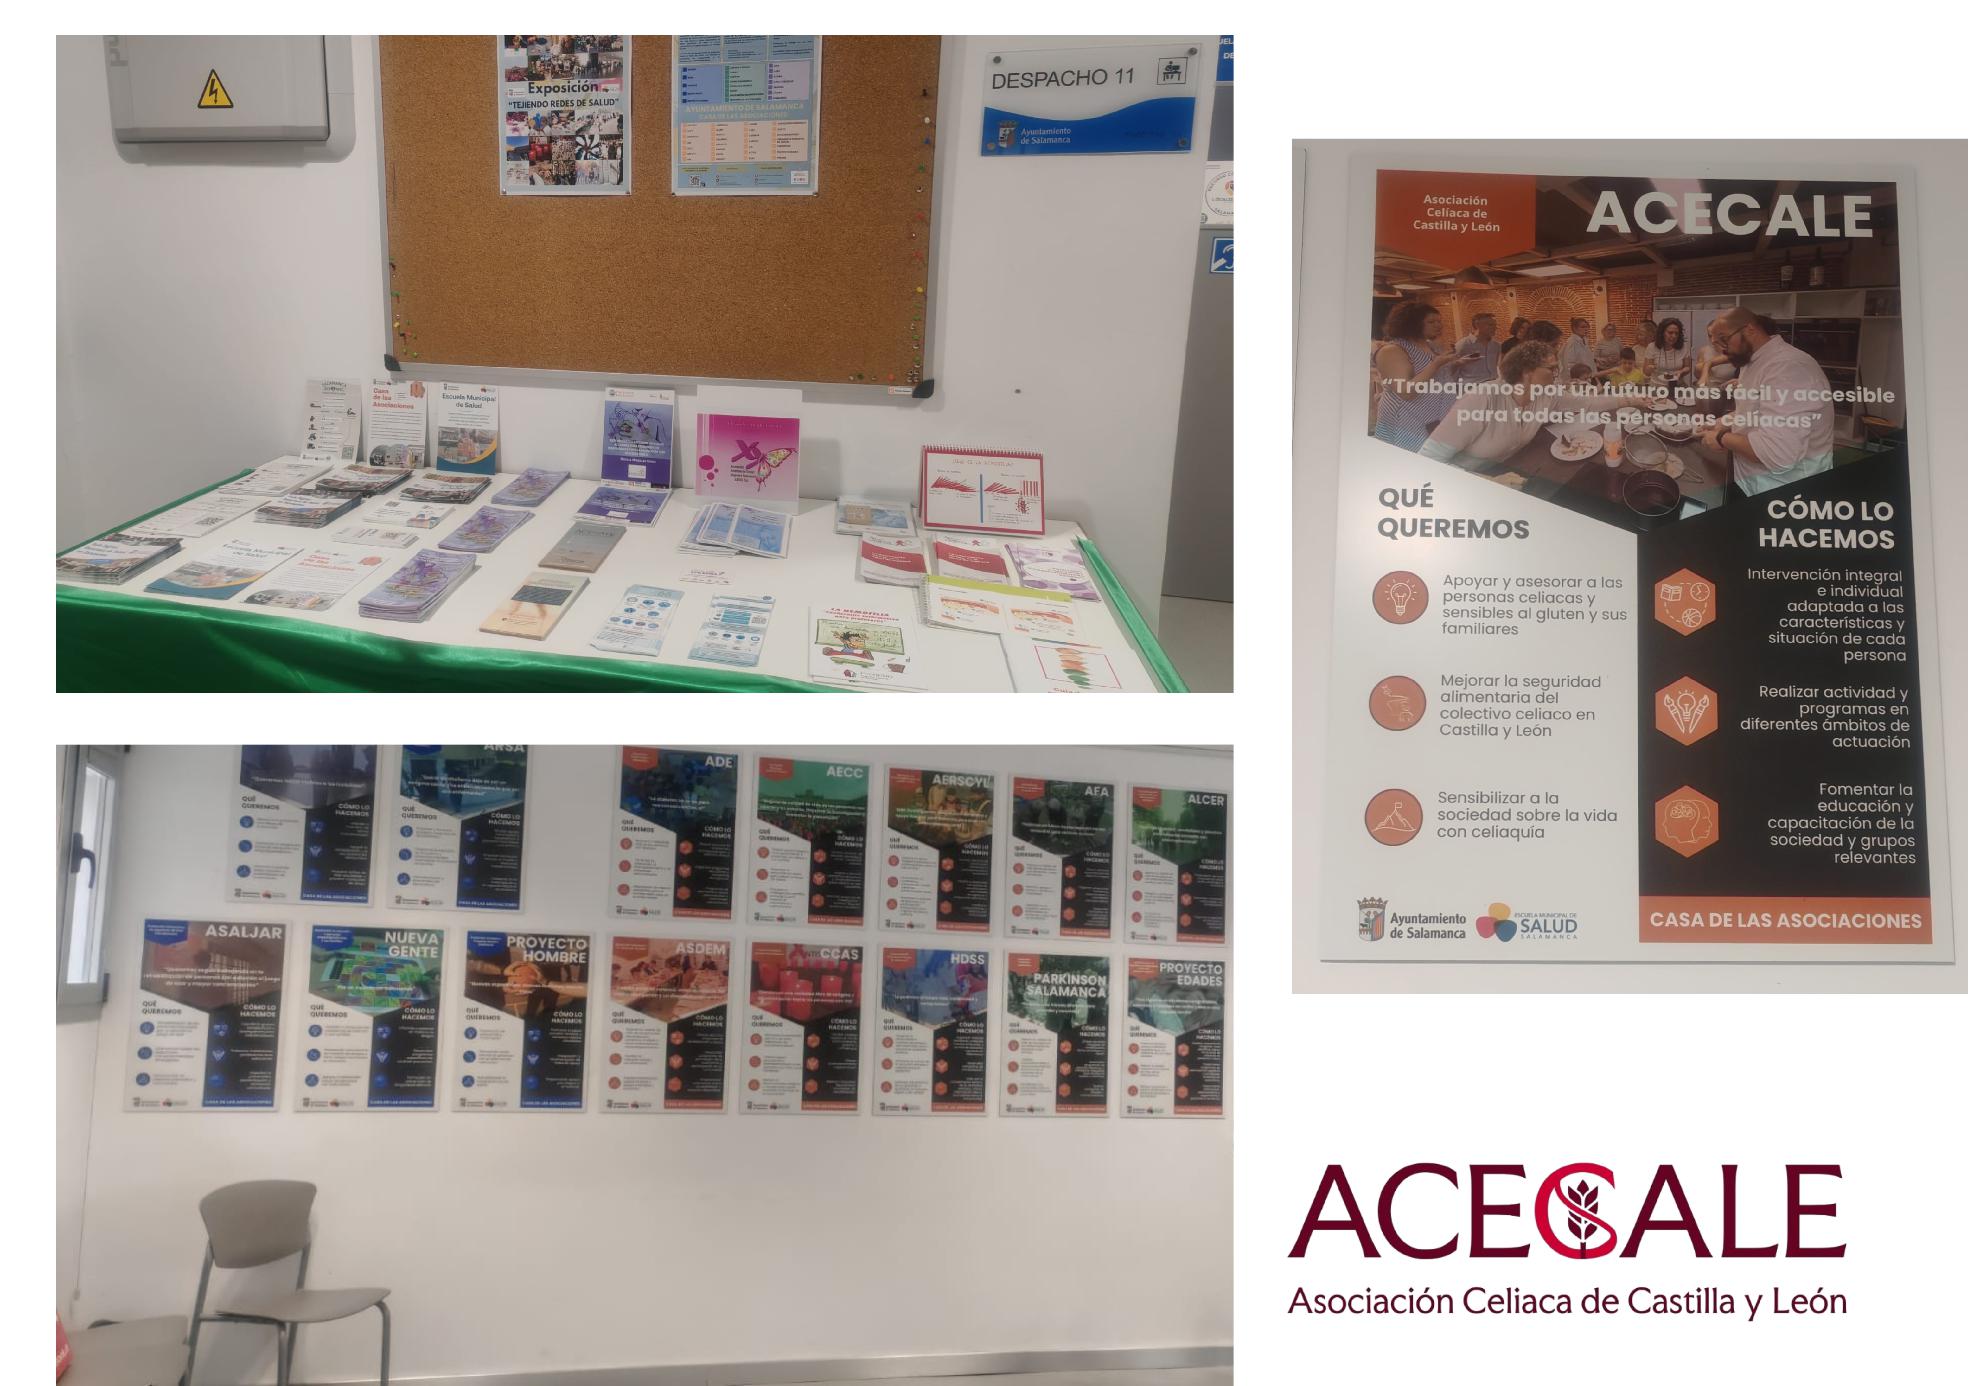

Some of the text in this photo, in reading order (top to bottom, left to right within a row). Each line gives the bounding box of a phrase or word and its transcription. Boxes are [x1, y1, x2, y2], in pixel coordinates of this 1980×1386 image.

[992, 68, 1134, 89] DESPACHO 11
[528, 80, 599, 96] Exposición
[577, 99, 586, 107] DE
[1021, 128, 1071, 136] Ayuntamiento
[1032, 136, 1070, 144] Salamanca
[1424, 194, 1488, 206] Asociación
[1427, 206, 1487, 219] Celíaca de
[1586, 190, 1872, 238] ACECALE
[1413, 220, 1500, 234] Castilla y León
[1530, 382, 1567, 400] por
[1571, 383, 1598, 396] un
[1603, 381, 1670, 398] futuro
[1674, 383, 1720, 400] más
[1725, 383, 1772, 401] fácil
[1776, 389, 1790, 406] y
[1793, 386, 1896, 403] accesible
[1457, 408, 1508, 426] para
[1513, 407, 1575, 424] todas
[1580, 408, 1612, 424] las
[1616, 410, 1716, 428] personas
[1379, 482, 1434, 509] QUÉ
[1768, 494, 1894, 521] CÓMO LO
[1378, 518, 1530, 540] QUEREMOS
[1759, 528, 1895, 550] HACEMOS
[1443, 574, 1623, 590] Apoyar y asesorar a las
[1748, 568, 1902, 585] Intervención integral
[1817, 584, 1903, 597] e individual
[1443, 592, 1514, 606] personas
[1588, 595, 1596, 606] y
[1443, 607, 1627, 623] sensibles al gluten y sus
[1788, 601, 1904, 616] adaptada a las
[1442, 622, 1518, 635] familiares
[1779, 616, 1904, 632] características y
[1768, 632, 1906, 646] situación de cada
[1844, 650, 1906, 664] persona
[1441, 674, 1601, 690] Mejorar la seguridad
[1440, 691, 1559, 704] alimentaria del
[1760, 686, 1908, 702] Realizar actividad y
[1440, 708, 1595, 720] colectivo celiaco en
[1799, 703, 1909, 718] programas en
[1440, 724, 1552, 740] Castilla y León
[1740, 718, 1910, 732] diferentes ámbitos de
[1832, 735, 1911, 748] actuación
[705, 755, 733, 768] ADE
[826, 765, 863, 779] AECC
[932, 774, 990, 789] AERSCYL
[1084, 786, 1109, 797] AFA
[1819, 783, 1913, 796] Fomentar la
[1188, 794, 1224, 806] ALCER
[1438, 791, 1558, 804] Sensibilizar a la
[1818, 799, 1914, 816] educación y
[1438, 808, 1617, 822] sociedad sobre la vida
[1768, 817, 1914, 832] capacitación de la
[1437, 826, 1545, 842] con celiaquía
[1770, 833, 1915, 851] sociedad y grupos
[1835, 851, 1916, 864] relevantes
[1390, 913, 1466, 926] Ayuntamiento
[1520, 918, 1578, 933] SALUD
[1650, 912, 1922, 929] CASA DE LAS ASOCIACIONES
[205, 924, 282, 939] ASALJAR
[385, 931, 439, 945] NUEVA
[1390, 928, 1466, 940] de Salamanca
[506, 935, 586, 950] PROYECTO
[676, 942, 726, 955] ASDEM
[388, 946, 438, 958] GENTE
[522, 950, 586, 964] HOMBRE
[820, 948, 859, 960] CCAS
[951, 953, 985, 965] HDSS
[1160, 962, 1223, 975] PROYECTO
[1033, 973, 1107, 986] PARKINSON
[1177, 975, 1223, 987] EDADES
[1027, 985, 1107, 999] SALAMANCA
